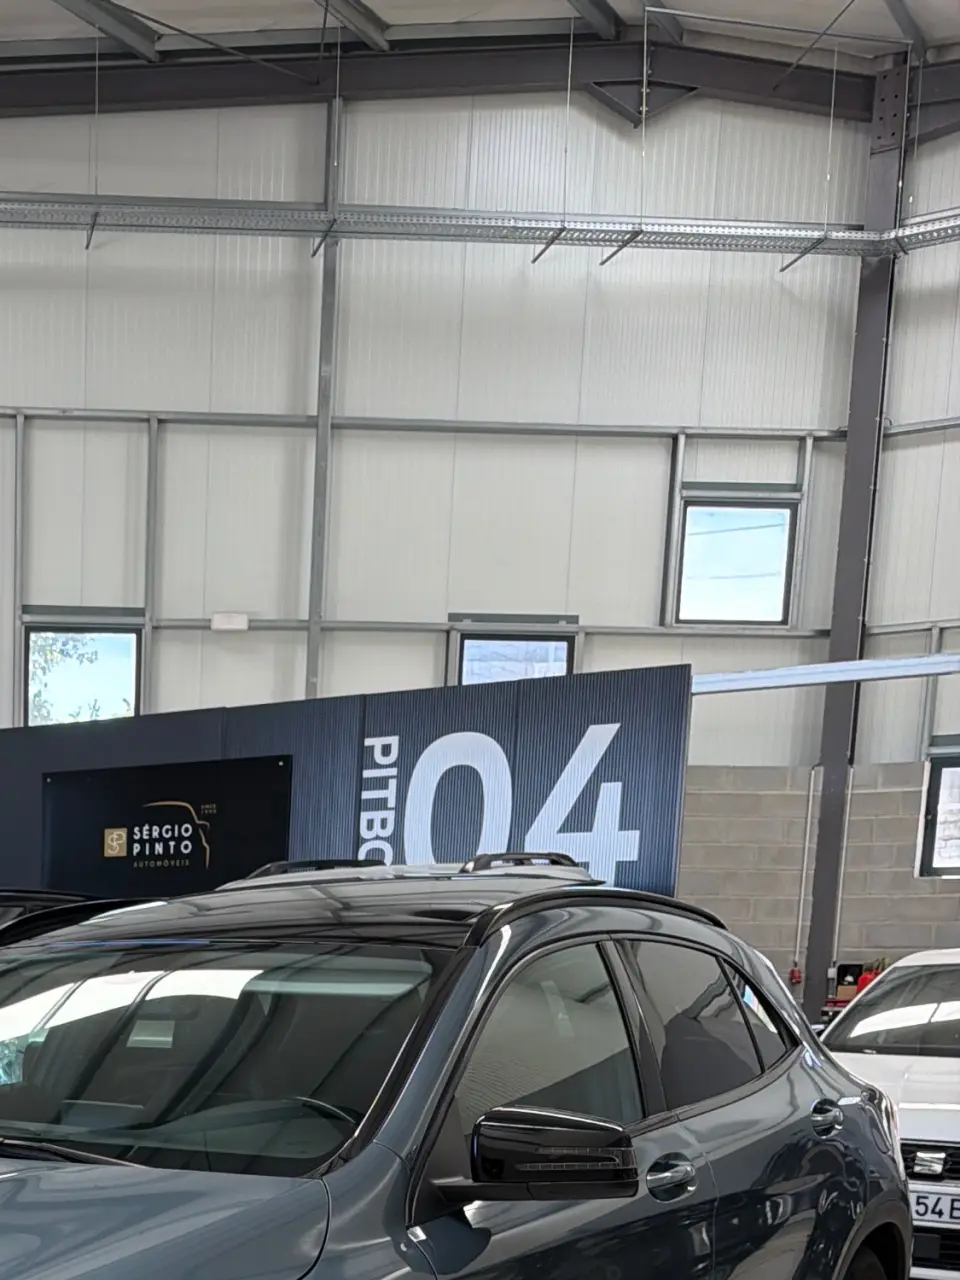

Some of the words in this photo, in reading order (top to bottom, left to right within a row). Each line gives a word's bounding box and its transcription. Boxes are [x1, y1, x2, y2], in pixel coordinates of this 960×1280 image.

[403, 722, 641, 888] 04
[133, 824, 192, 840] SÉRGIO
[133, 840, 192, 856] PINTO
[133, 859, 189, 868] AUTOMÓVEIS
